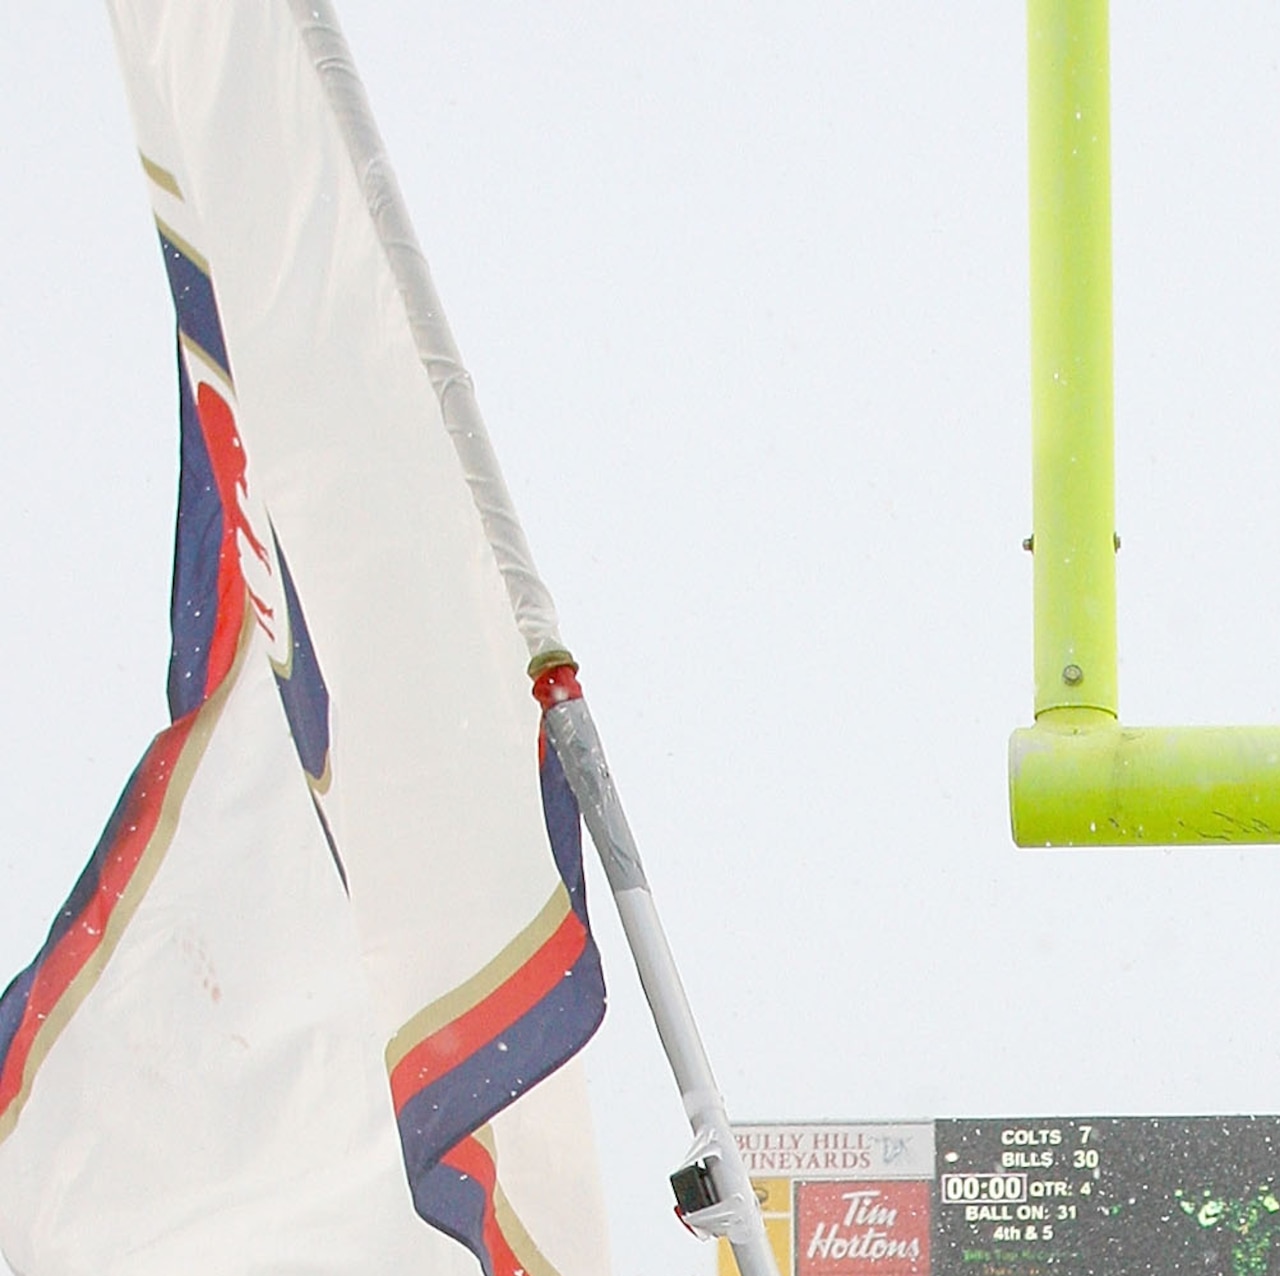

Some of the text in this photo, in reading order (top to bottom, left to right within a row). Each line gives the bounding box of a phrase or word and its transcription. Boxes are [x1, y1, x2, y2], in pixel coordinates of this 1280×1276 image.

[735, 1133, 871, 1151] BULLY HILL
[1001, 1126, 1092, 1145] COLTS 7
[1002, 1150, 1099, 1168] BILLS 30
[947, 1177, 1091, 1199] 00:00 QTR: 4
[842, 1190, 897, 1226] Tim
[965, 1205, 1076, 1220] BALL ON: 31
[807, 1223, 919, 1259] Hortons
[993, 1226, 1053, 1240] 4th & 5
